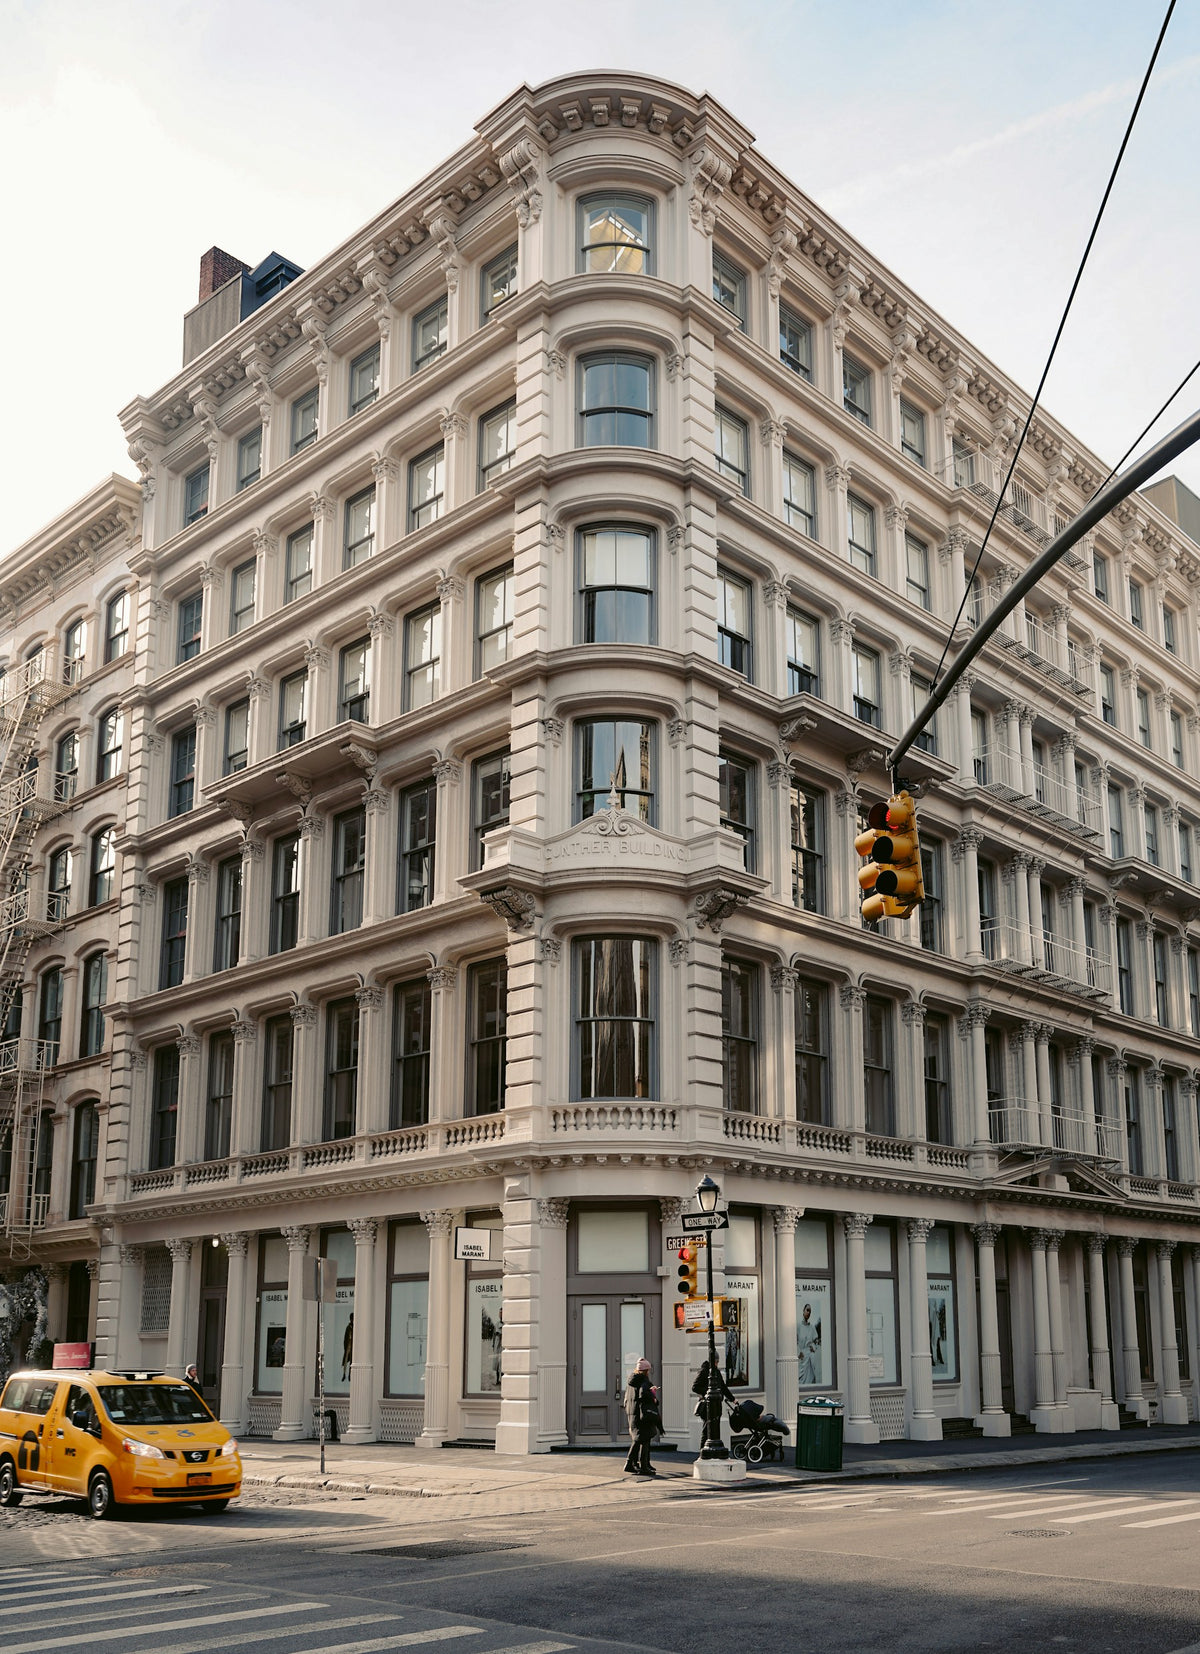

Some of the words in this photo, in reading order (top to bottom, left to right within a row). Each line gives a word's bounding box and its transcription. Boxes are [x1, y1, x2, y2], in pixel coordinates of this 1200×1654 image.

[544, 841, 611, 860] GUNTHER
[619, 840, 686, 861] BUILDING
[688, 1218, 702, 1226] ONE
[707, 1216, 721, 1225] WAY
[475, 1284, 498, 1293] ISABEL
[727, 1281, 755, 1290] MARANT
[802, 1284, 826, 1292] MARANT
[265, 1294, 283, 1302] ISABEL
